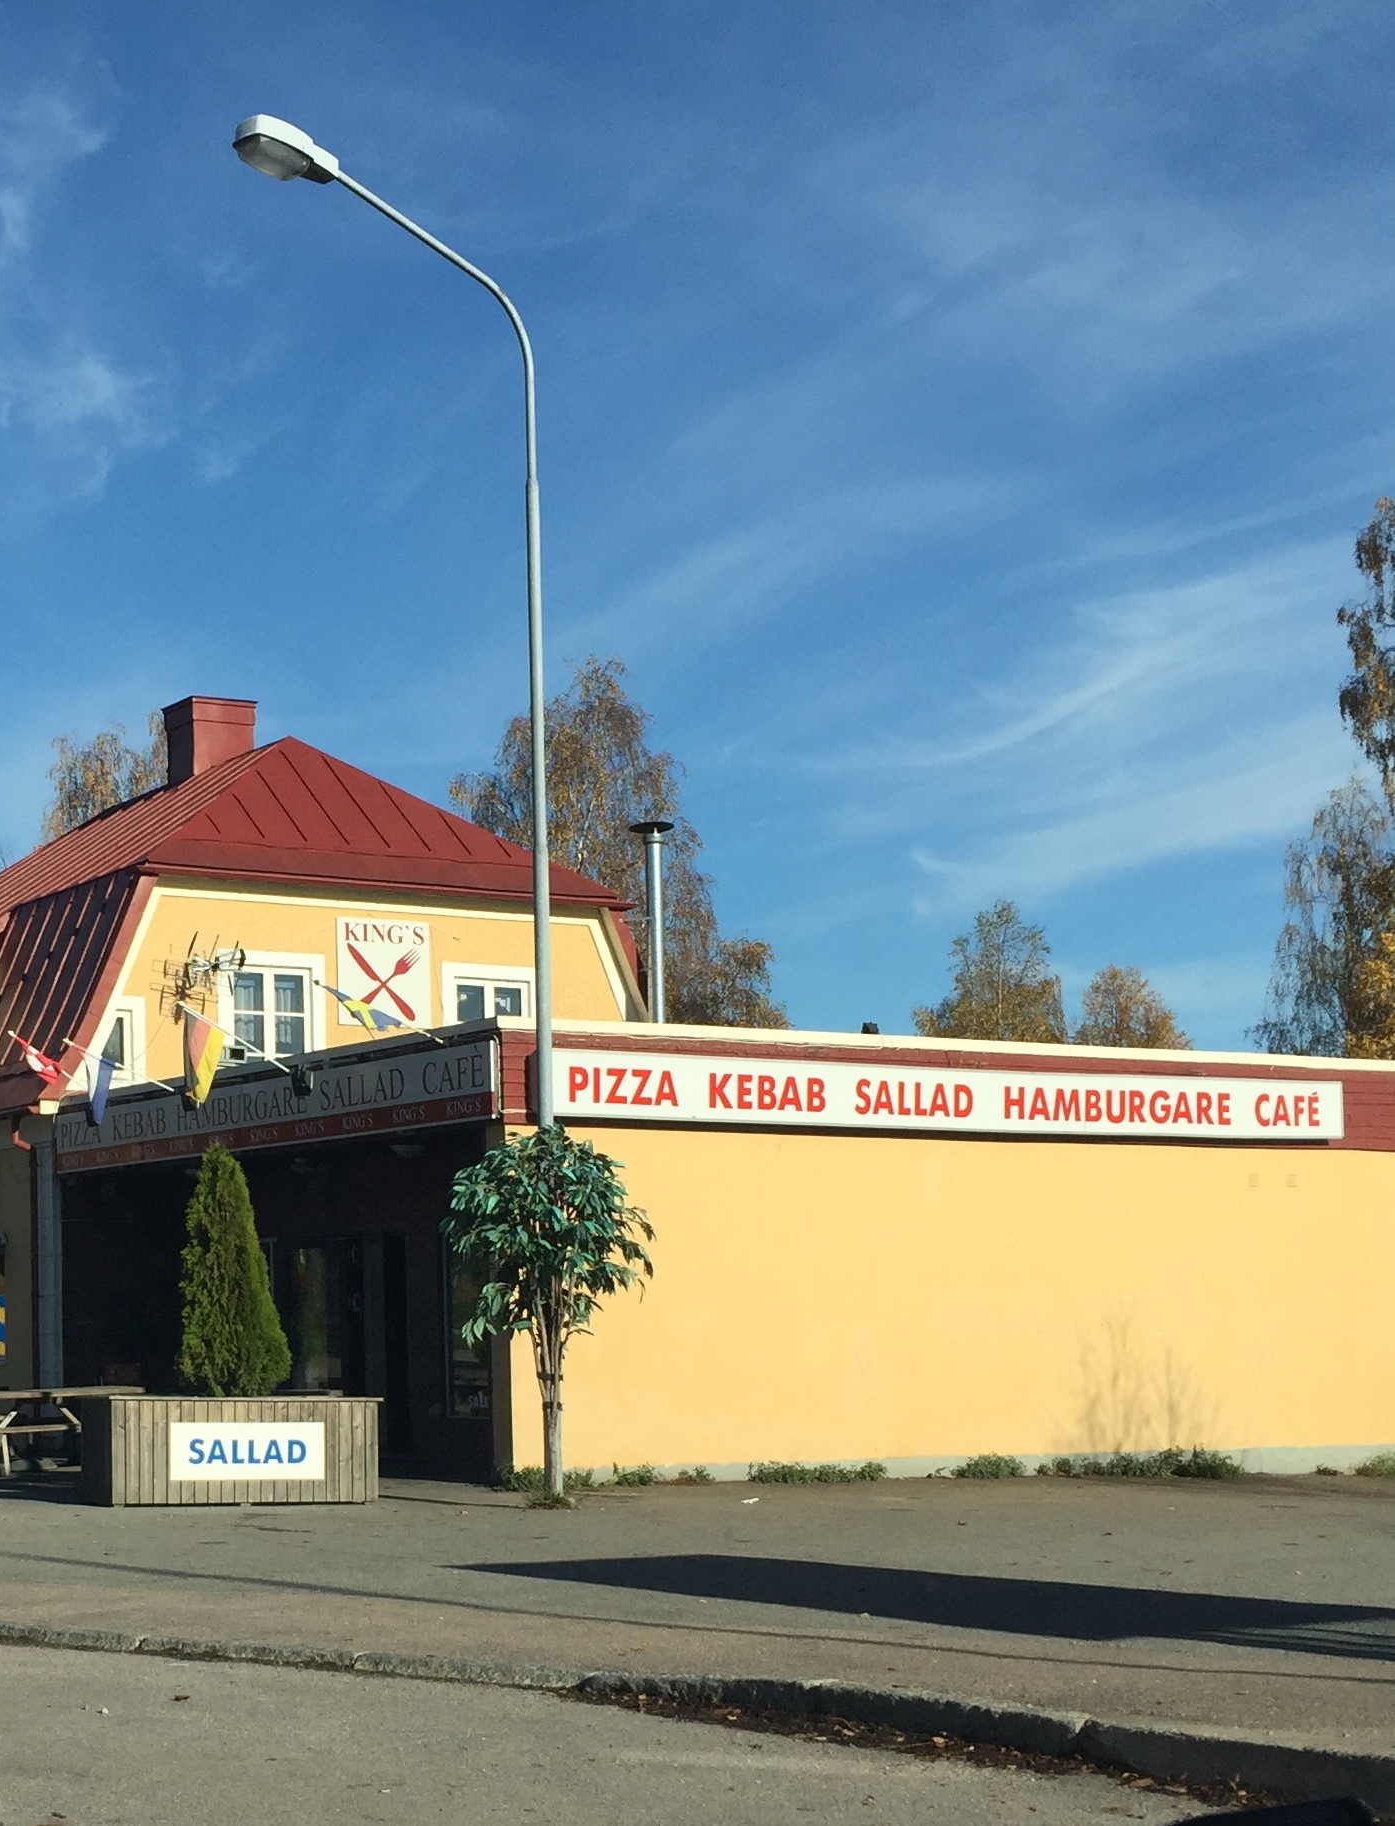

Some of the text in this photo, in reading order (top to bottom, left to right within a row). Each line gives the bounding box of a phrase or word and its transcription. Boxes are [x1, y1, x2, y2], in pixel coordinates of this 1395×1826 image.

[60, 1119, 102, 1149] PIZZA
[112, 1106, 167, 1142] KEBAB
[319, 1067, 405, 1111] SALLAD
[568, 1066, 1321, 1127] PIZZA KEBAB SALLAD HAMBURGARE CAFÉ
[188, 1437, 308, 1465] SALLAD
